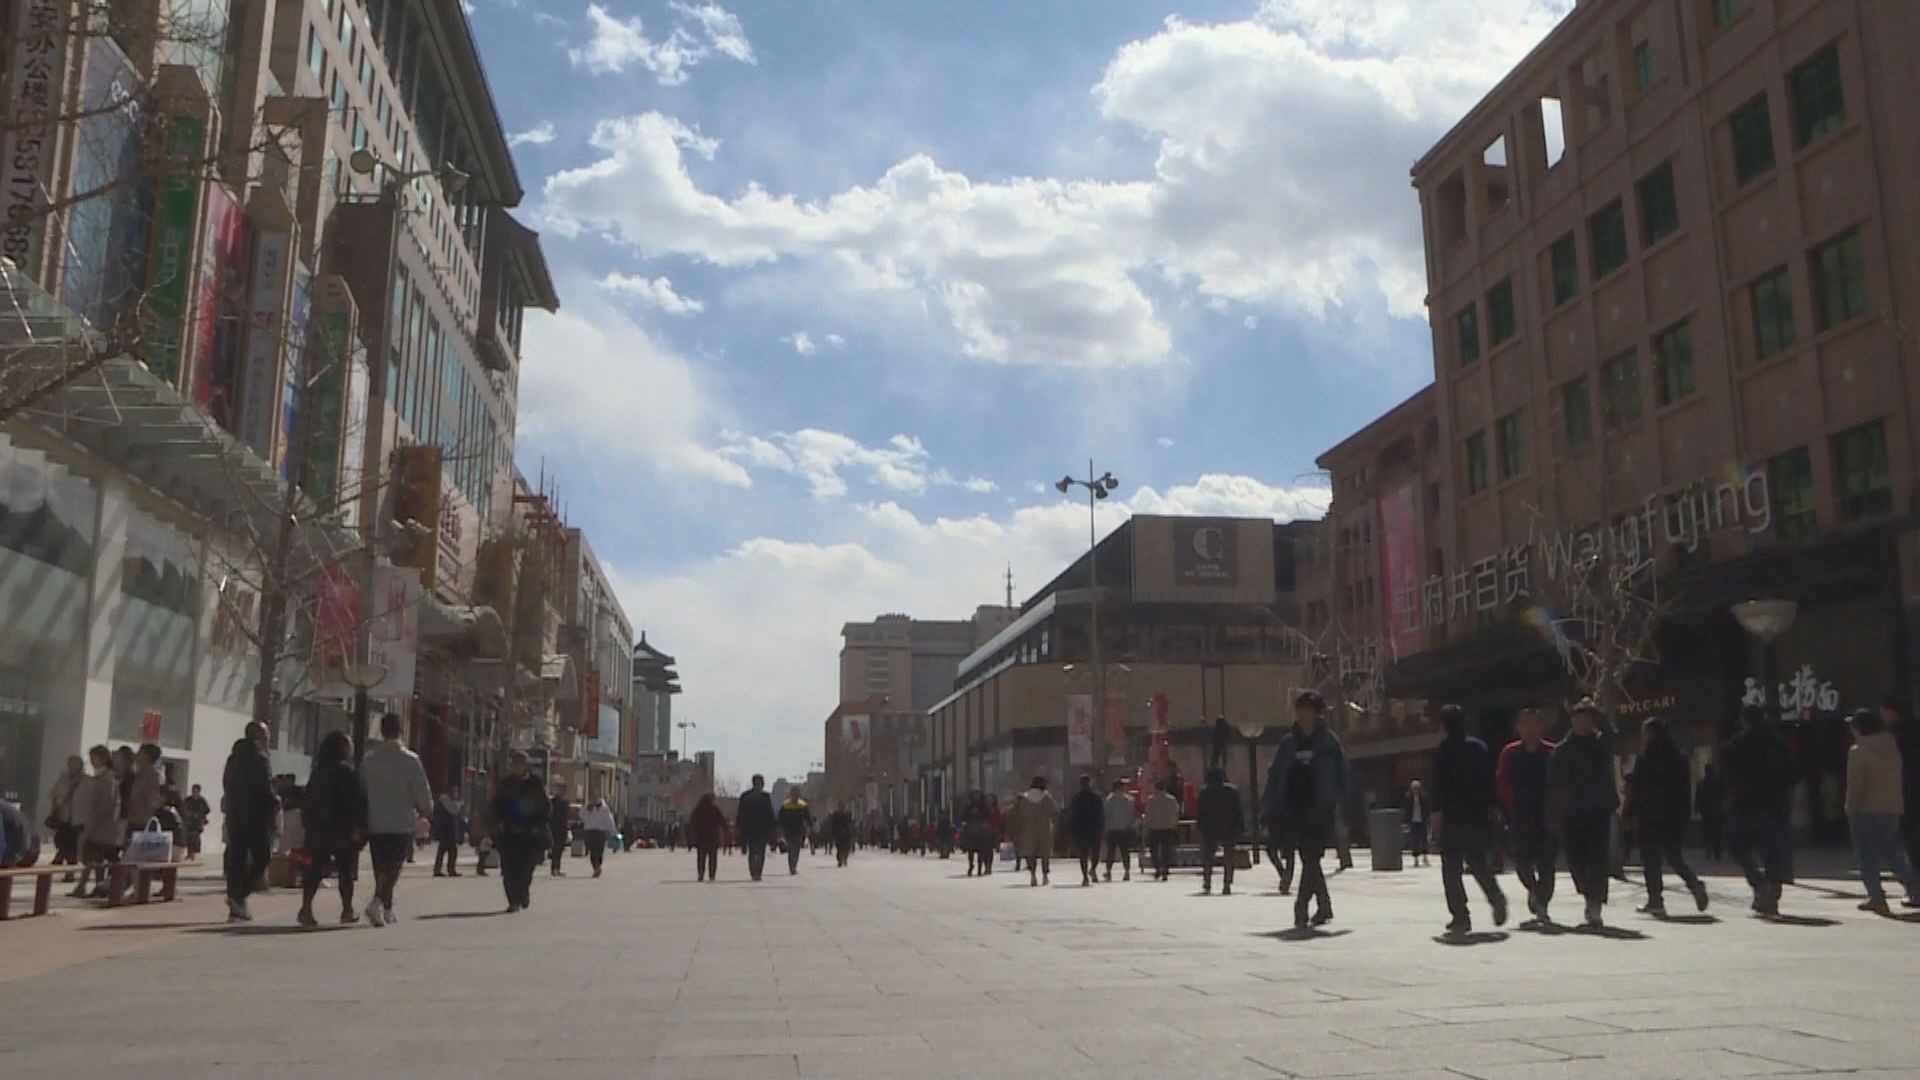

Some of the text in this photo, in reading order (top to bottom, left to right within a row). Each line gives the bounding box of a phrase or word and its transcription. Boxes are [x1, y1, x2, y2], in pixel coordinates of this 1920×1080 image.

[1537, 470, 1772, 581] Wangfujing
[1394, 545, 1530, 634] 王府井百货
